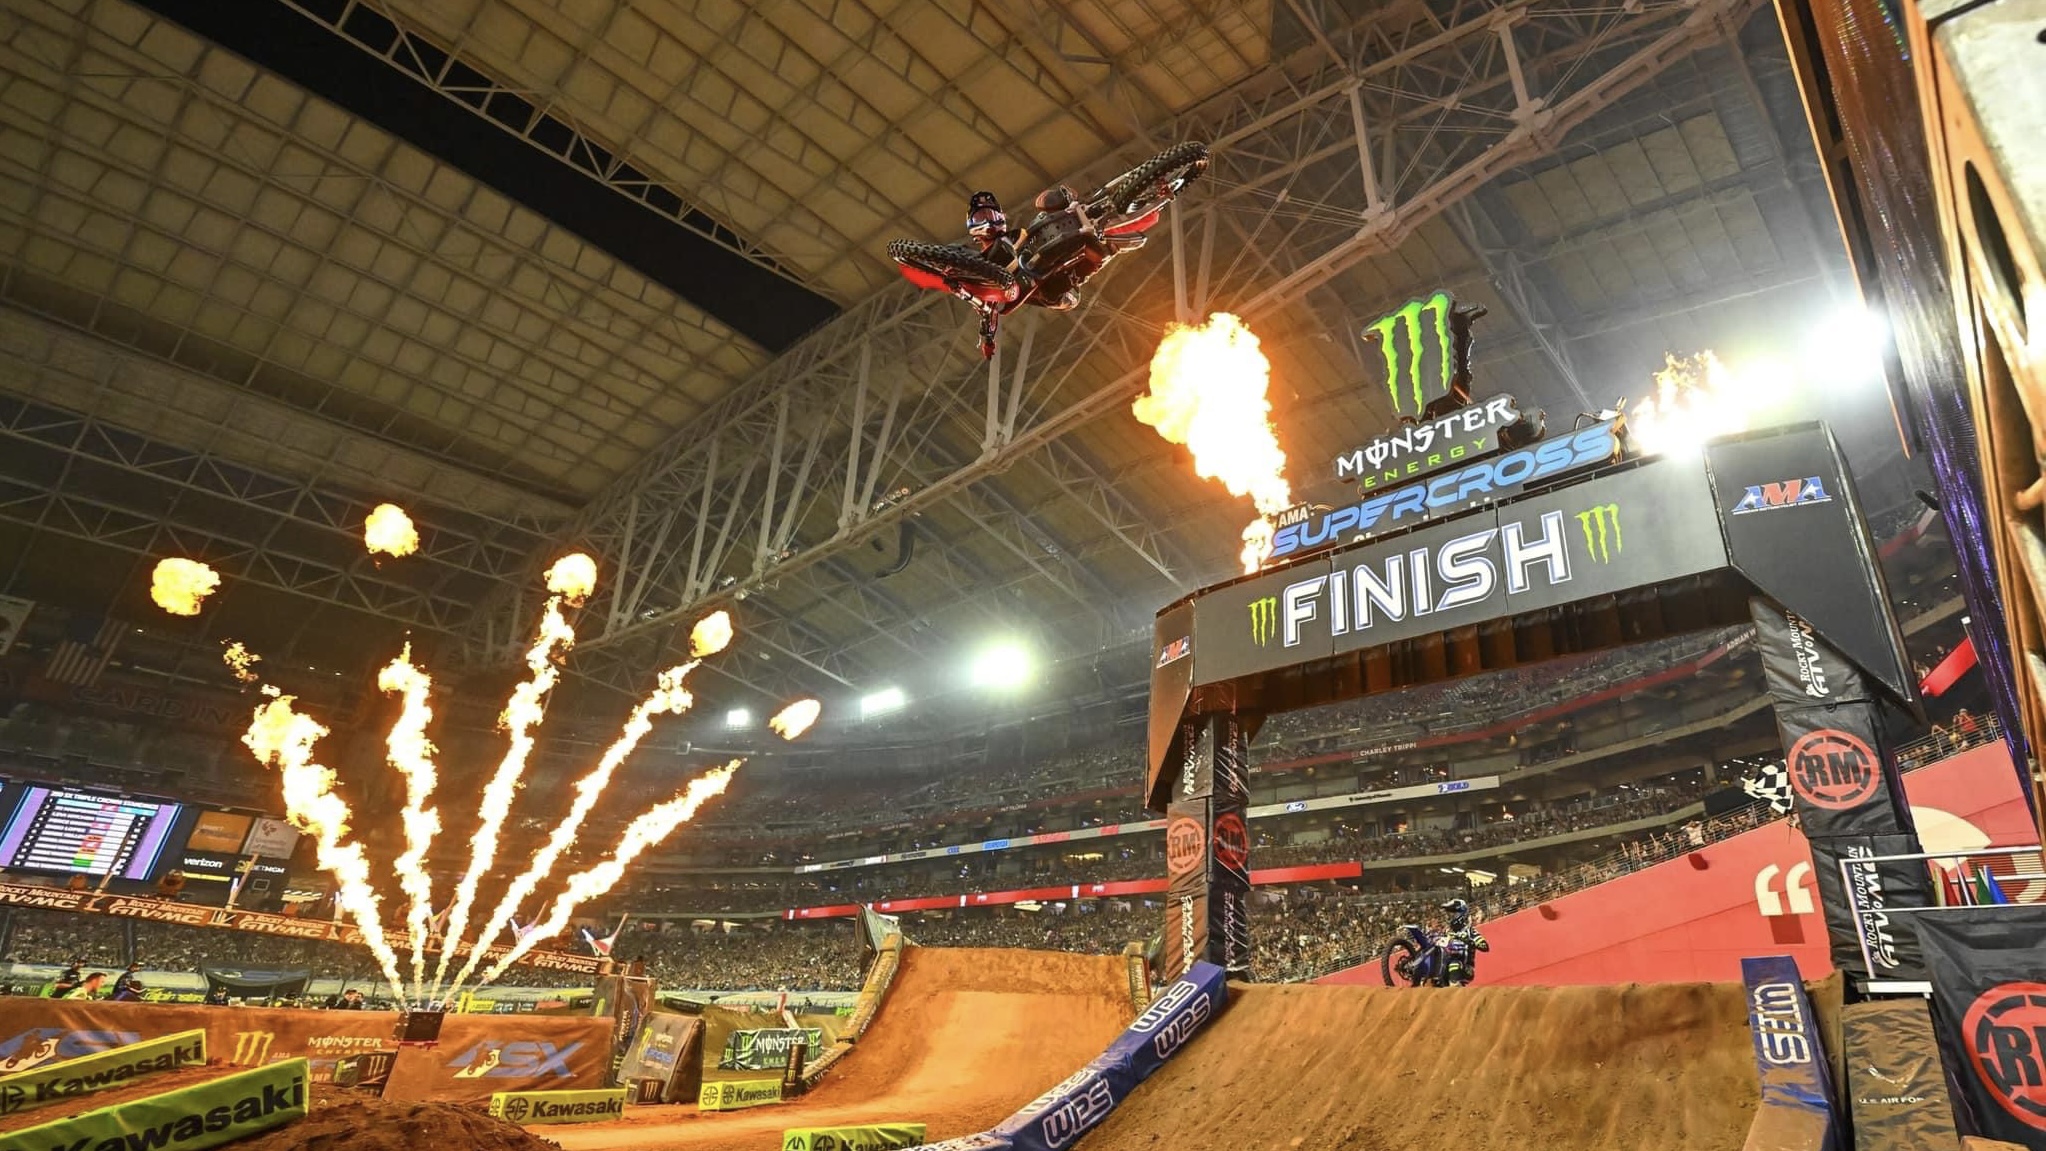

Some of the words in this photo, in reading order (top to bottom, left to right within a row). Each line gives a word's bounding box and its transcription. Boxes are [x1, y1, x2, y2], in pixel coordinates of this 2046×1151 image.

[1337, 397, 1519, 477] MONSTER
[1364, 437, 1487, 489] ENERGY
[1269, 422, 1615, 556] SUPERCROSS
[1731, 476, 1831, 513] AMA
[1278, 508, 1310, 528] AMA
[1283, 509, 1572, 648] FINISH
[1157, 635, 1190, 669] AMA
[1359, 745, 1392, 757] CHARLEY
[1393, 742, 1417, 753] TRIPPI
[1803, 751, 1861, 787] RM
[1170, 832, 1198, 854] RM
[184, 857, 223, 869] verizon
[253, 865, 286, 874] ETMGM
[1847, 846, 1870, 909] MOUNTIN
[1862, 912, 1878, 949] ROCKY
[1130, 980, 1198, 1032] WPS
[308, 1036, 382, 1049] MONSTER
[1154, 993, 1211, 1059] WPS
[36, 1040, 202, 1102] Kawasaki
[532, 1098, 623, 1118] Kawasaki
[735, 1086, 781, 1102] Kawasaki
[1880, 1097, 1899, 1105] AIR
[1042, 1078, 1114, 1149] WPS
